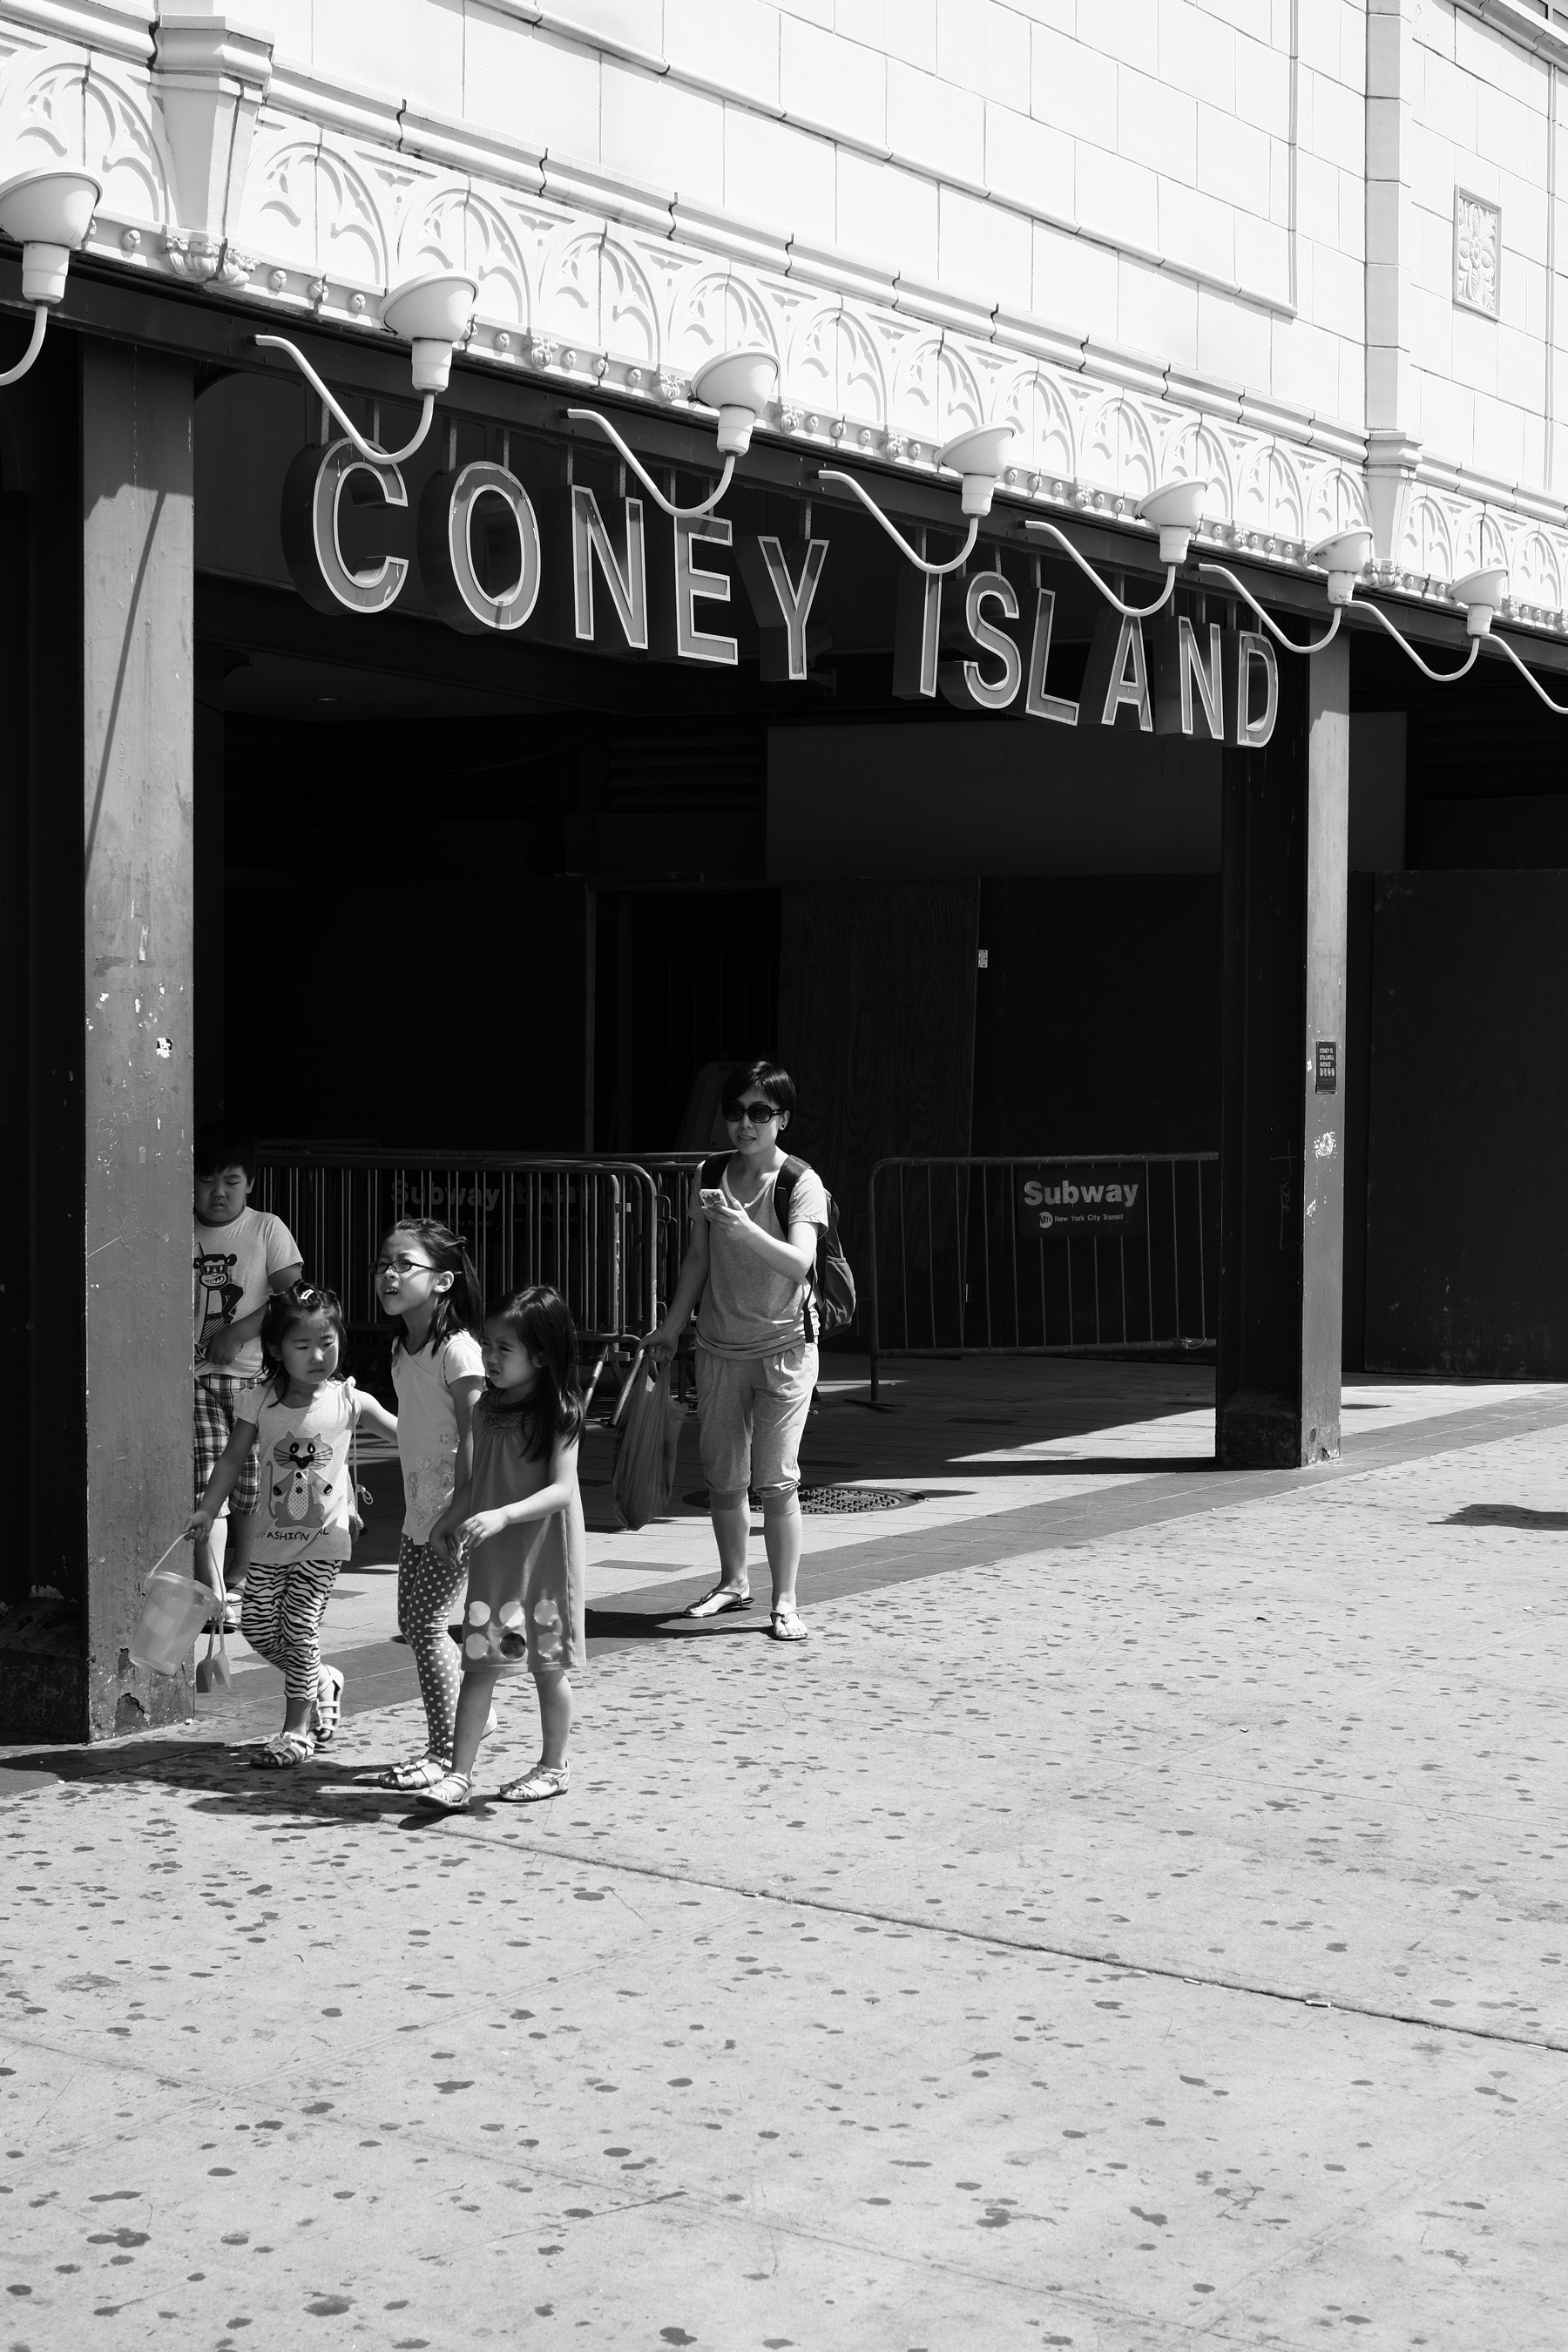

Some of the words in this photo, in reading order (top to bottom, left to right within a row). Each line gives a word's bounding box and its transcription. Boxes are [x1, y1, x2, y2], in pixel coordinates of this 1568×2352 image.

[311, 436, 829, 681] CONEY
[918, 564, 1279, 748] ISLAND
[1024, 1179, 1139, 1207] Subway
[1087, 1213, 1101, 1222] City
[1102, 1213, 1124, 1221] Transit
